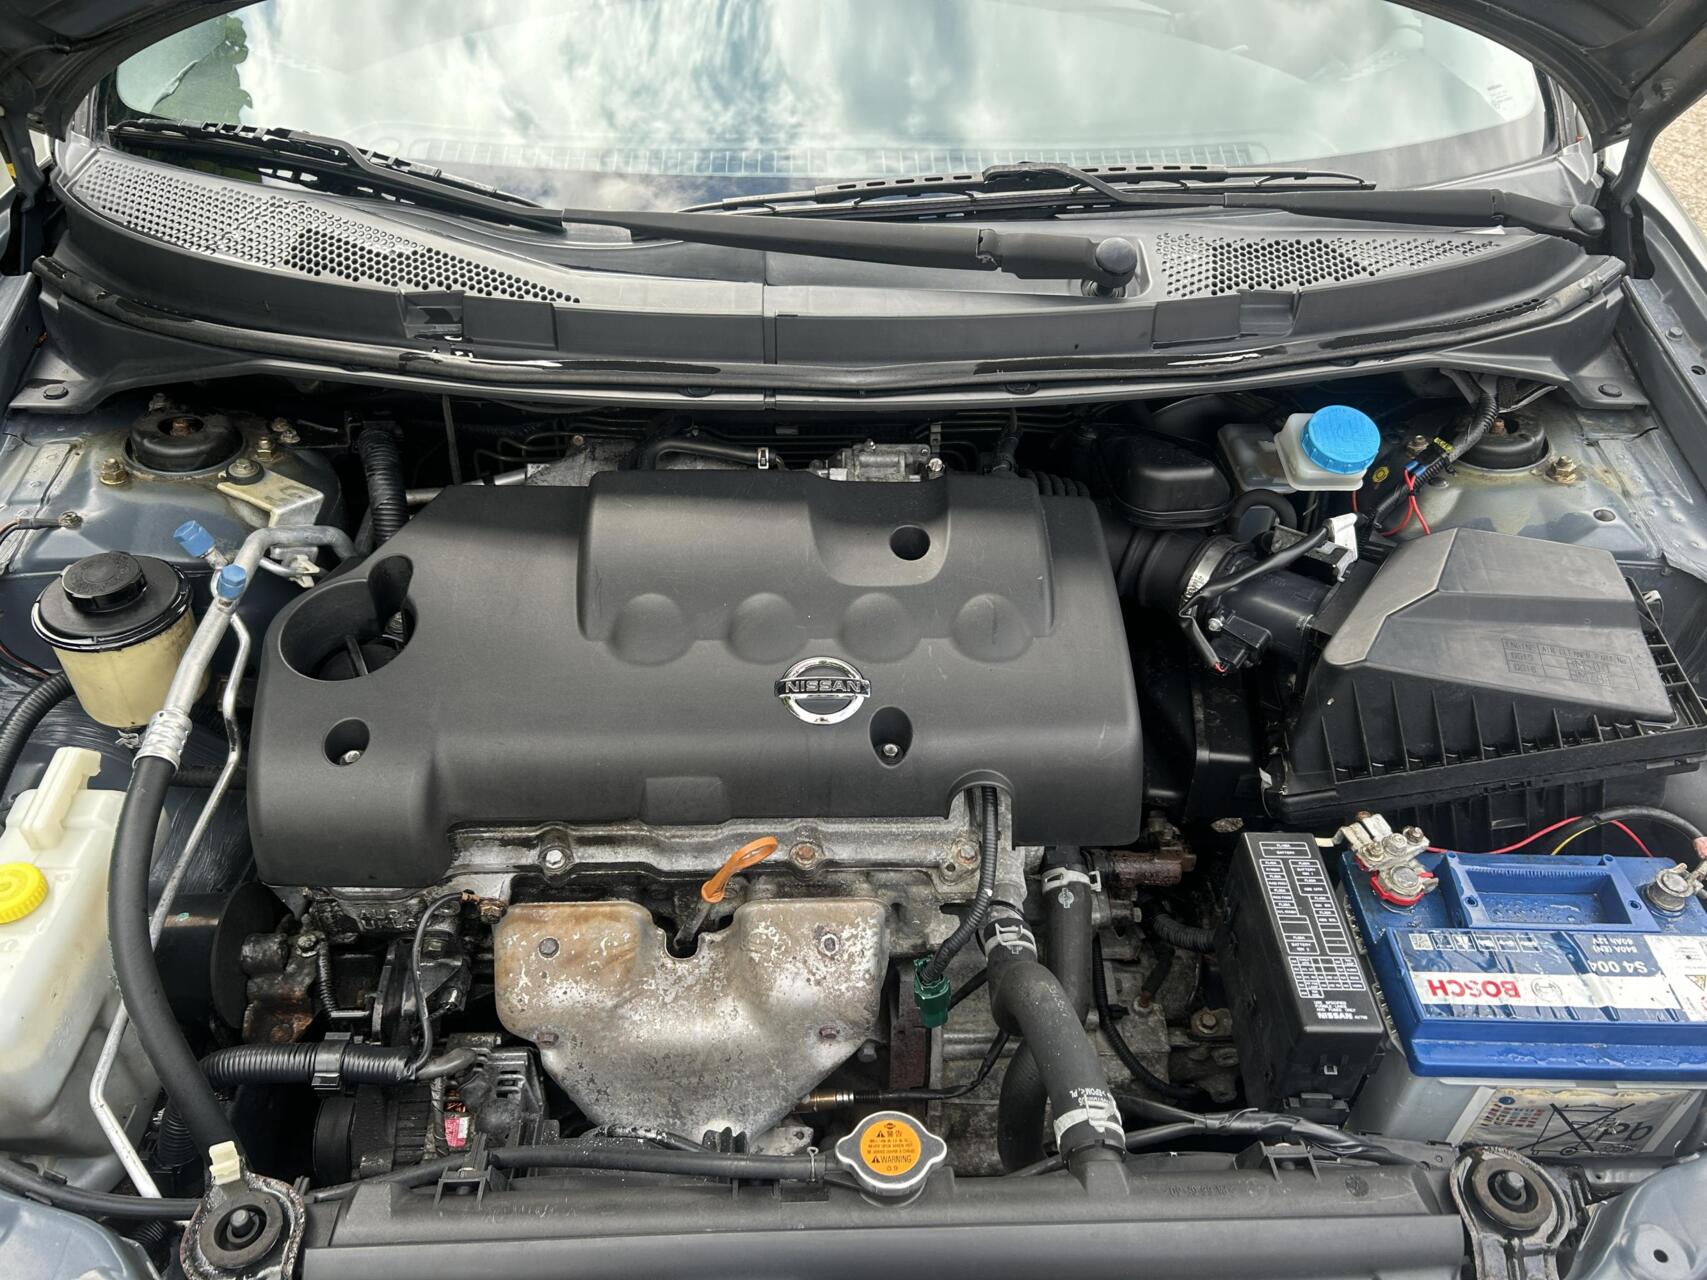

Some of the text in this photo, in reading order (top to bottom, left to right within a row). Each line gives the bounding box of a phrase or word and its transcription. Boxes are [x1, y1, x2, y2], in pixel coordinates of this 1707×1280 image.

[785, 680, 861, 693] NISSAN
[1587, 959, 1648, 974] S4 004
[1427, 979, 1521, 998] BOSCH
[1317, 1012, 1353, 1020] NISSAN
[881, 1155, 912, 1163] WARNING
